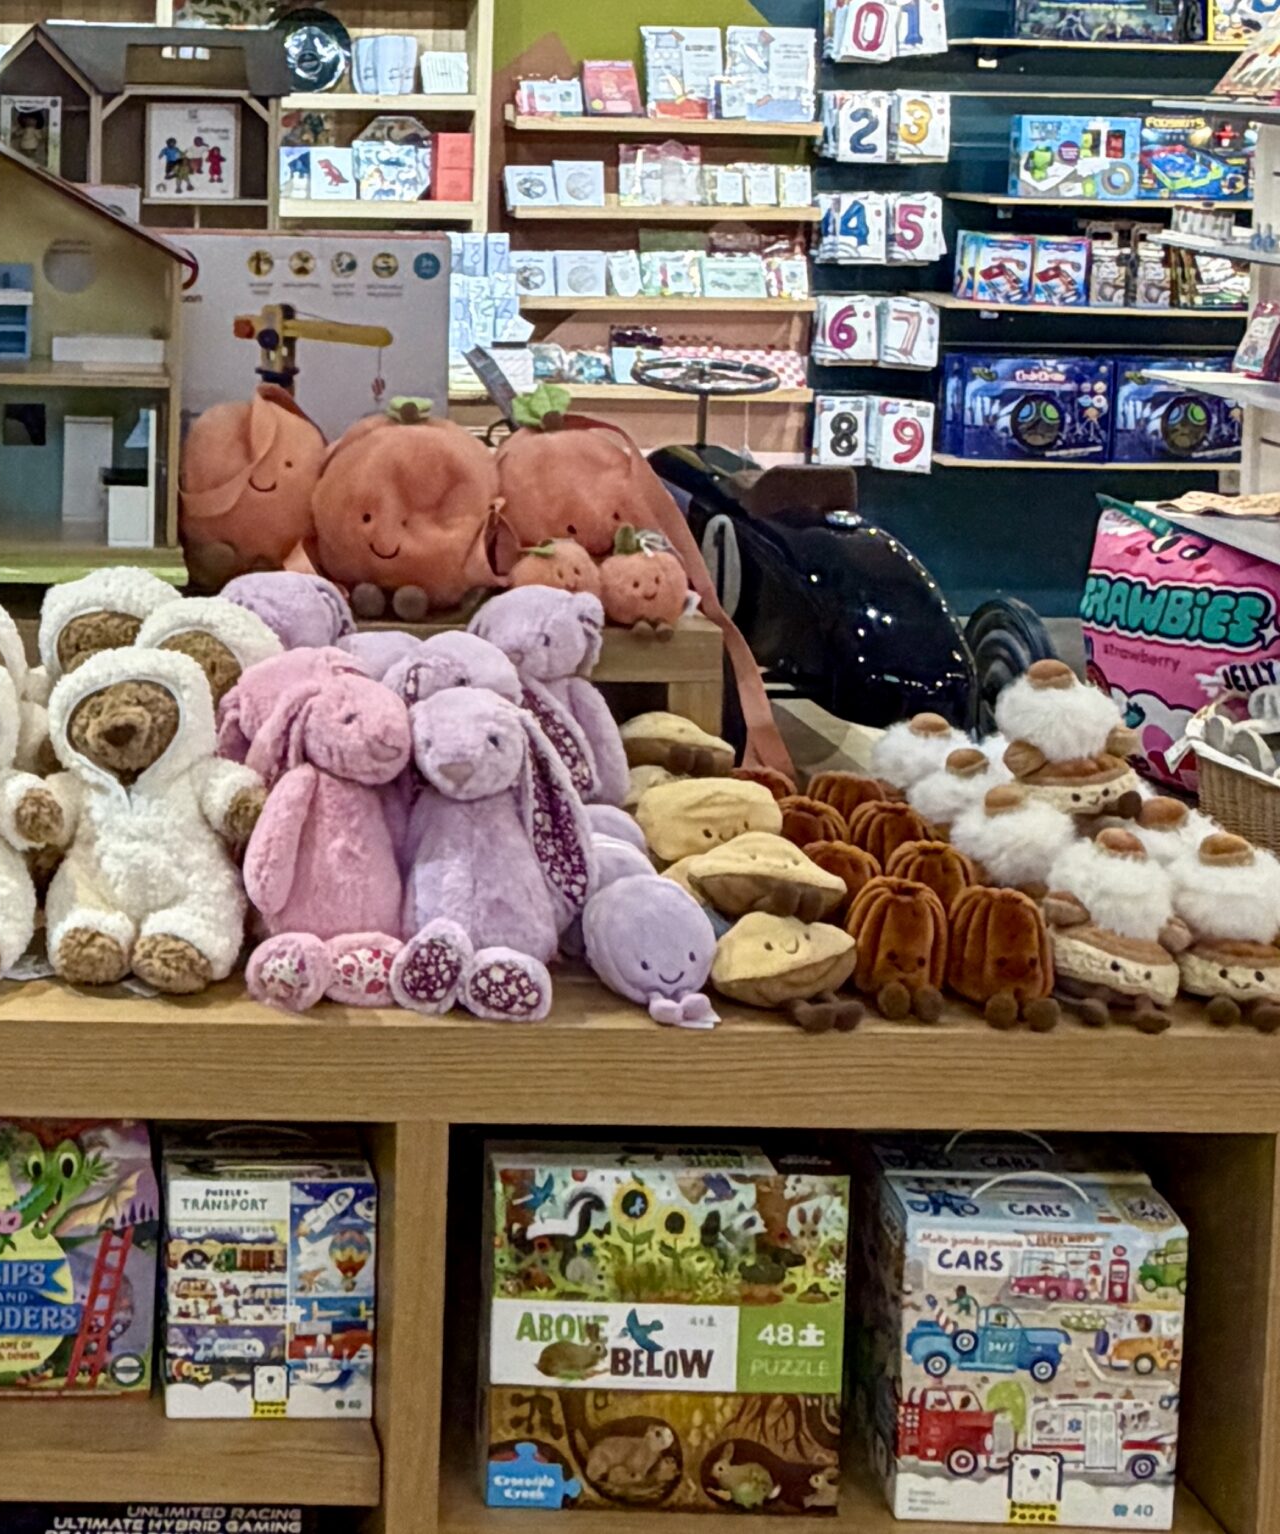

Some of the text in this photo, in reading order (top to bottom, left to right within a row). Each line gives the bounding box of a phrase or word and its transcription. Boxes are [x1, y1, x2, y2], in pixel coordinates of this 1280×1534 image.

[852, 2, 886, 52] 0
[901, 0, 923, 46] 1
[850, 107, 880, 155] 2
[900, 99, 933, 145] 3
[839, 200, 869, 247] 4
[896, 203, 927, 250] 5
[828, 304, 858, 350] 6
[892, 308, 923, 357] 7
[830, 411, 859, 457] 8
[893, 417, 925, 464] 9
[1223, 661, 1277, 692] JELLY
[181, 1198, 268, 1211] TRANSPORT
[1008, 1203, 1071, 1218] CARS
[938, 1249, 1004, 1272] CARS
[516, 1311, 609, 1343] ABOVE
[757, 1323, 793, 1347] 48
[610, 1348, 714, 1379] BELOW
[750, 1358, 829, 1377] PUZZLE
[53, 1517, 302, 1534] ULTIMATE HYBRID GAMING
[127, 1505, 302, 1521] UNLIMITED RACING
[1010, 1510, 1057, 1522] Panda
[1133, 1505, 1153, 1517] 40
